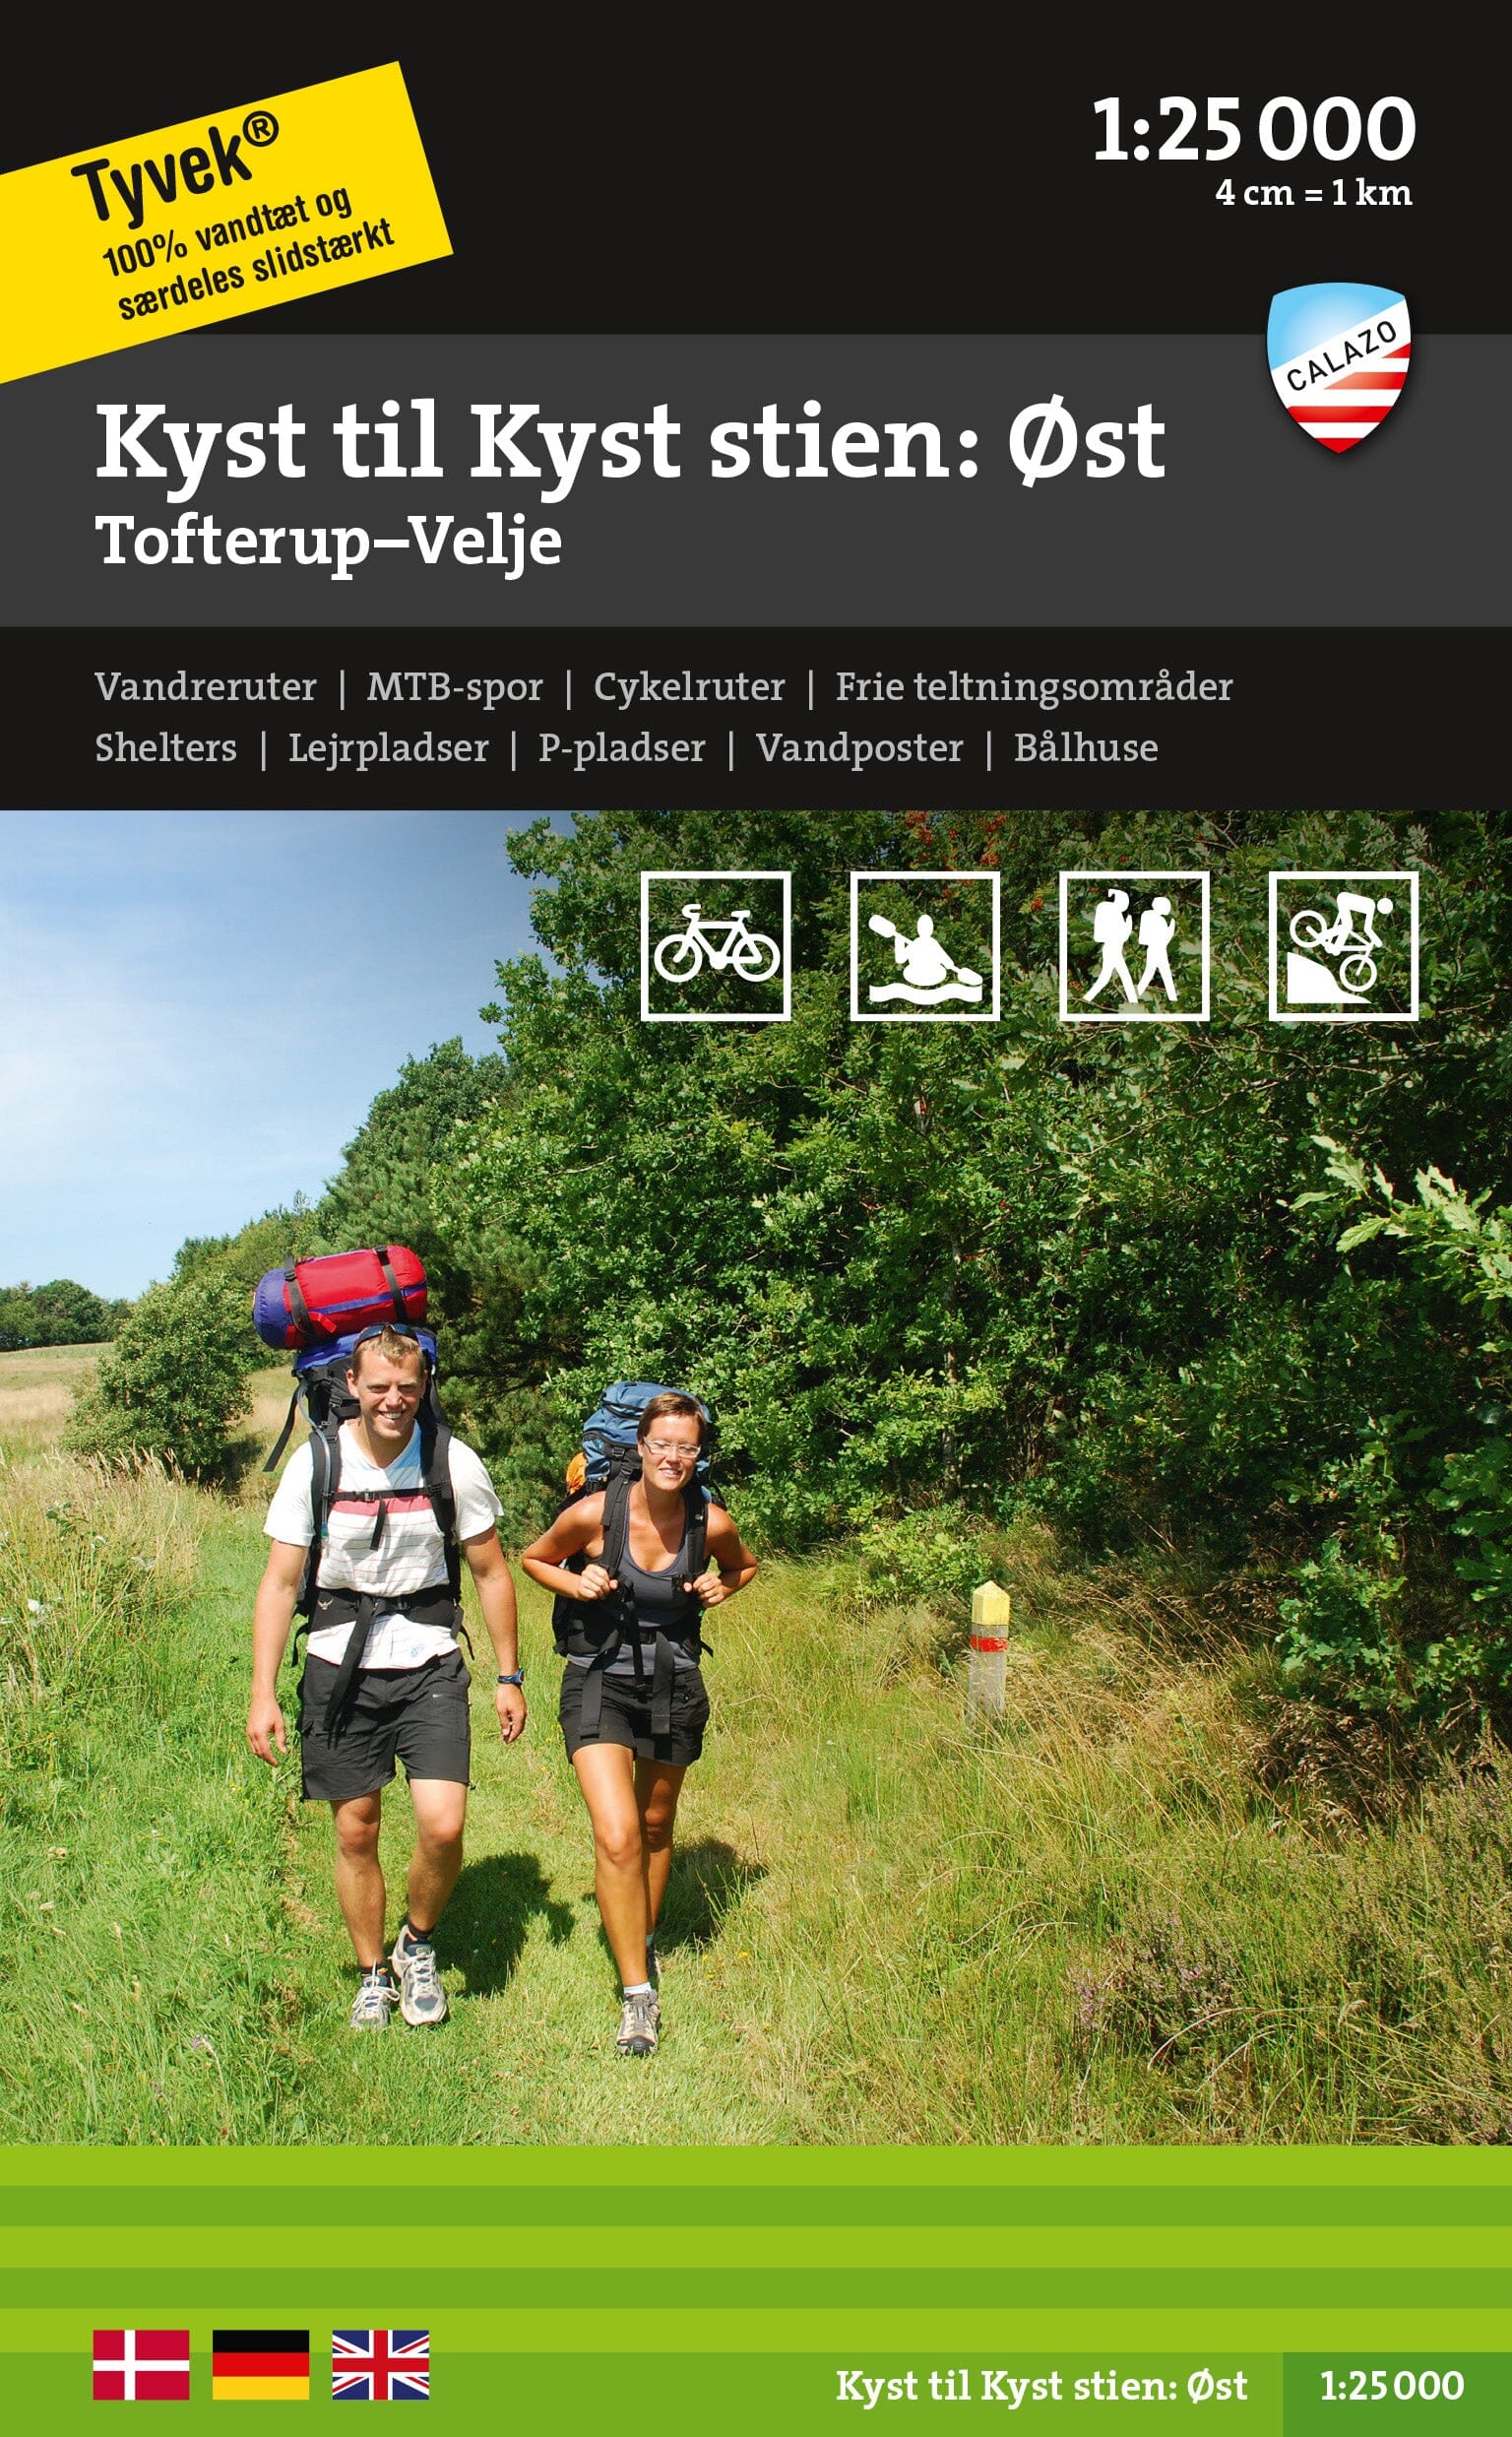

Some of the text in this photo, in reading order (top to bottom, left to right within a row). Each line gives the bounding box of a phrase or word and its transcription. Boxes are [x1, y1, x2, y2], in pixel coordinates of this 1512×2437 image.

[1216, 179, 1235, 206] 4
[1244, 186, 1294, 206] cm
[1333, 179, 1347, 206] 1
[1356, 177, 1414, 206] km
[102, 188, 352, 277] 100% vandtæt og
[118, 218, 395, 320] særdeles slidstærkt
[1288, 321, 1396, 390] CALAZO
[96, 394, 1166, 504] Kyst til Kyst stien: Øst
[94, 669, 1233, 710] Vandreruter MTB-spor Cykelruter Frie teltningsområder
[95, 730, 1159, 771] Shelters Lejrpladser P-pladser Vandposter Bålhuse
[836, 2368, 1247, 2409] Kyst til Kyst stien: Øst
